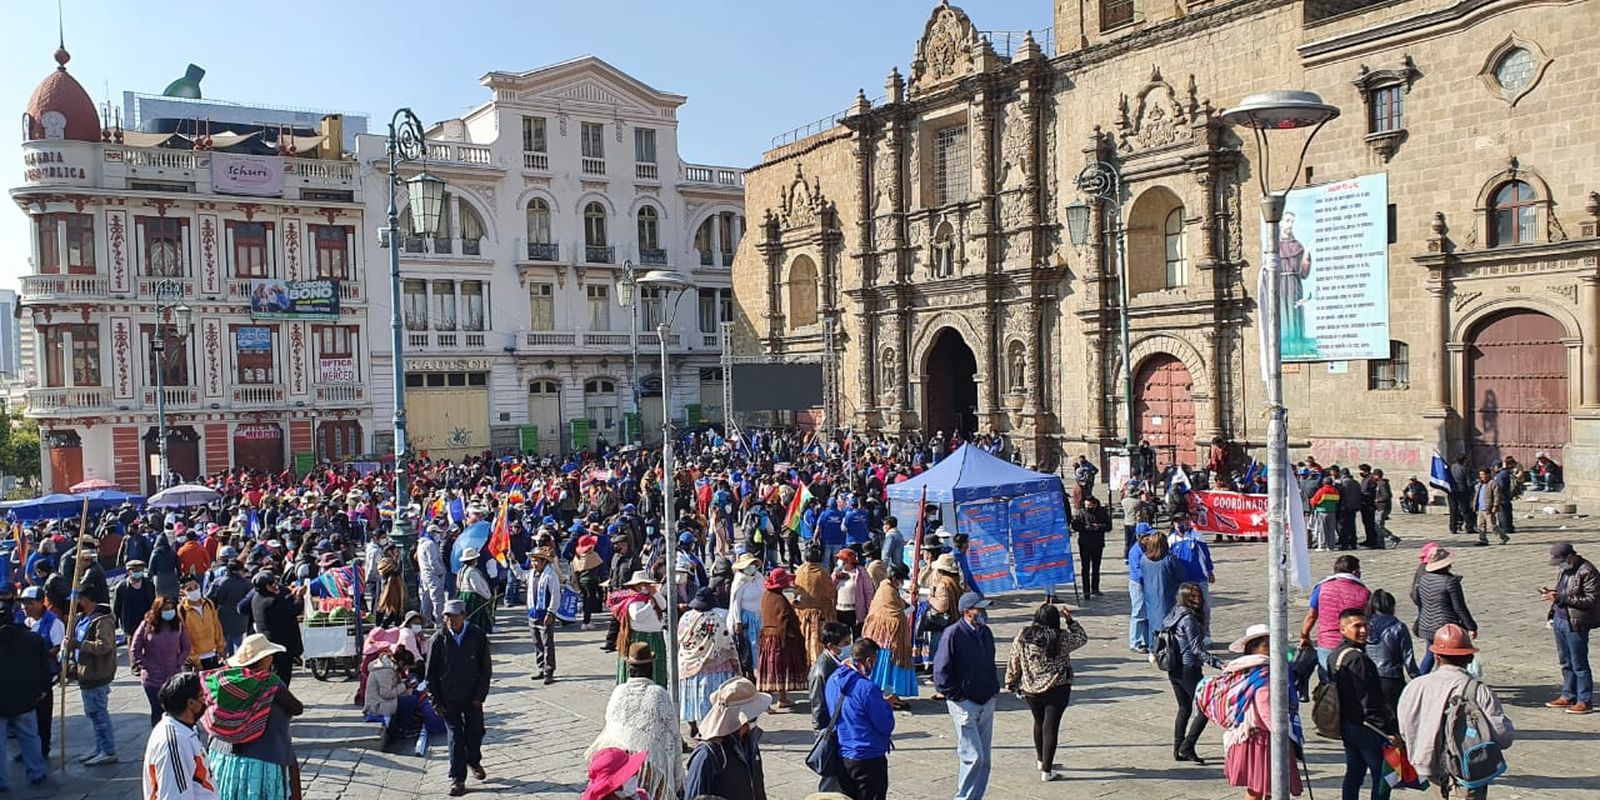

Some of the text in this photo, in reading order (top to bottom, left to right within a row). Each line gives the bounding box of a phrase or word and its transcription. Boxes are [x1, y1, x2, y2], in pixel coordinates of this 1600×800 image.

[293, 280, 332, 289] CORONA
[289, 288, 333, 300] BONO
[322, 359, 352, 367] OPTICA
[322, 371, 354, 381] MERCED
